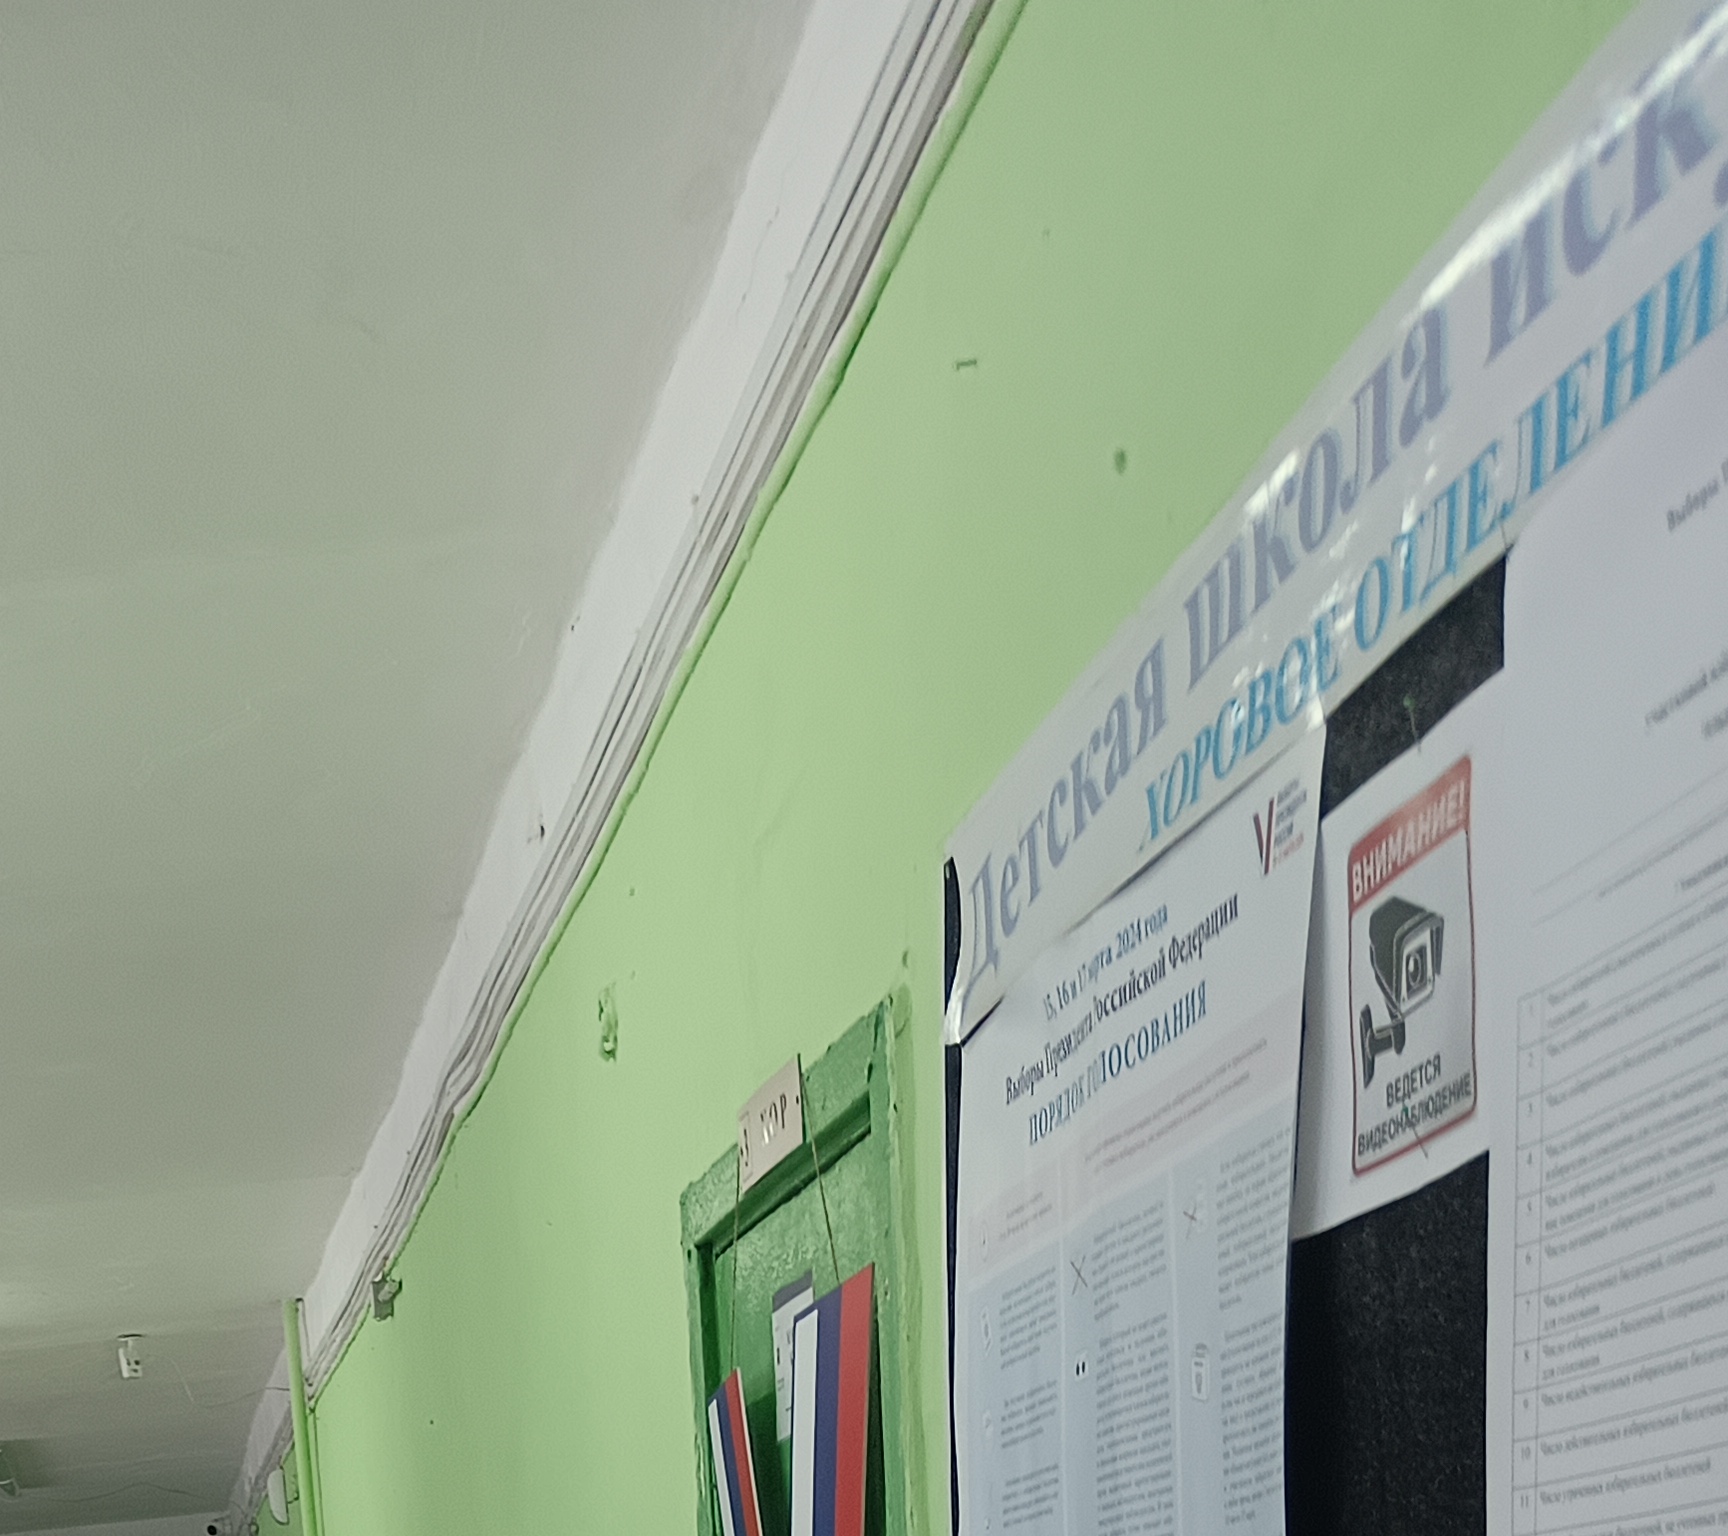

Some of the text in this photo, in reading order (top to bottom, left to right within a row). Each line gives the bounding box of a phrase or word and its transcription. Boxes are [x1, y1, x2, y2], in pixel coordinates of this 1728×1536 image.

[1138, 225, 1728, 852] ХОРОВОЕ ОТДЕЛЕНИ
[967, 634, 1169, 985] Детская
[1183, 300, 1452, 695] школа
[1352, 778, 1466, 902] ВНИМАНИЕ!
[1115, 913, 1143, 960] 2024
[1144, 903, 1168, 938] года
[1006, 1060, 1044, 1105] Выборы
[1168, 894, 1239, 970] Федерации
[1029, 1074, 1085, 1146] ПОРЯДОК
[1357, 1072, 1472, 1157] ВИДЕОНАБЛЮДЕНИЕ
[1385, 1053, 1442, 1108] ВЕДЕТСЯ
